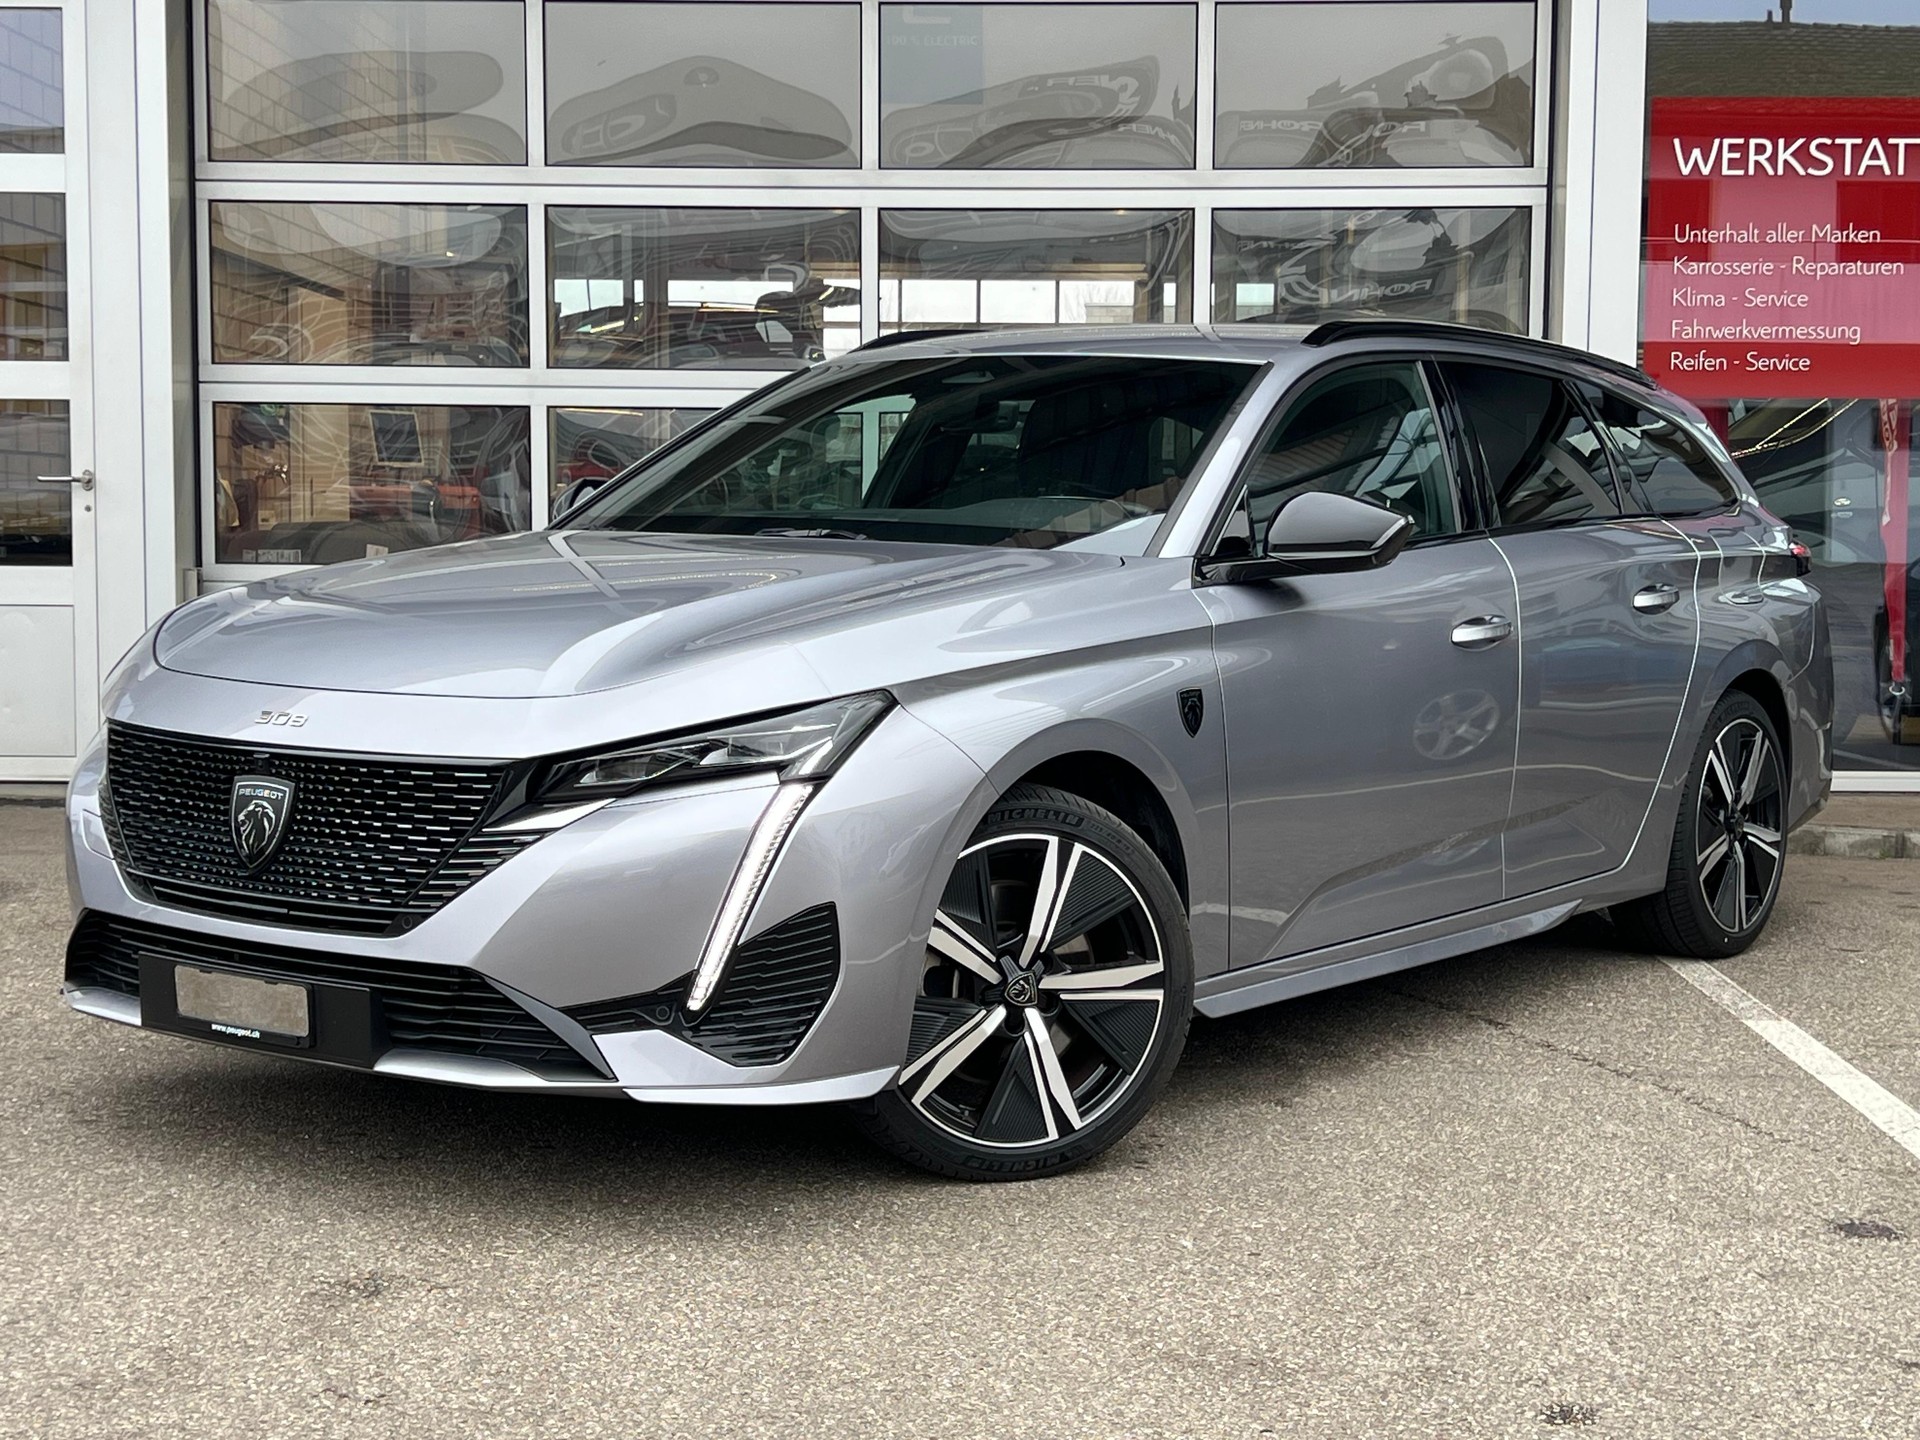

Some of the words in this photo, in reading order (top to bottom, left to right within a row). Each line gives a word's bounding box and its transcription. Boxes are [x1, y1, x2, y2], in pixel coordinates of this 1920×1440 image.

[1673, 137, 1920, 176] WERKSTAT
[1674, 223, 1759, 243] Unterhalt
[1766, 223, 1805, 243] aller
[1812, 223, 1881, 243] Marken
[1673, 256, 1774, 275] Karrosserie
[1792, 256, 1904, 280] Reparaturen
[1672, 288, 1725, 307] Klima
[1744, 288, 1809, 307] Service
[1671, 319, 1861, 344] Fahrwerkvermessung
[1670, 350, 1728, 371] Reifen
[1745, 352, 1811, 371] Service
[254, 711, 309, 727] 308
[238, 788, 284, 801] PEUGEOT
[987, 808, 1080, 825] MICHELIN
